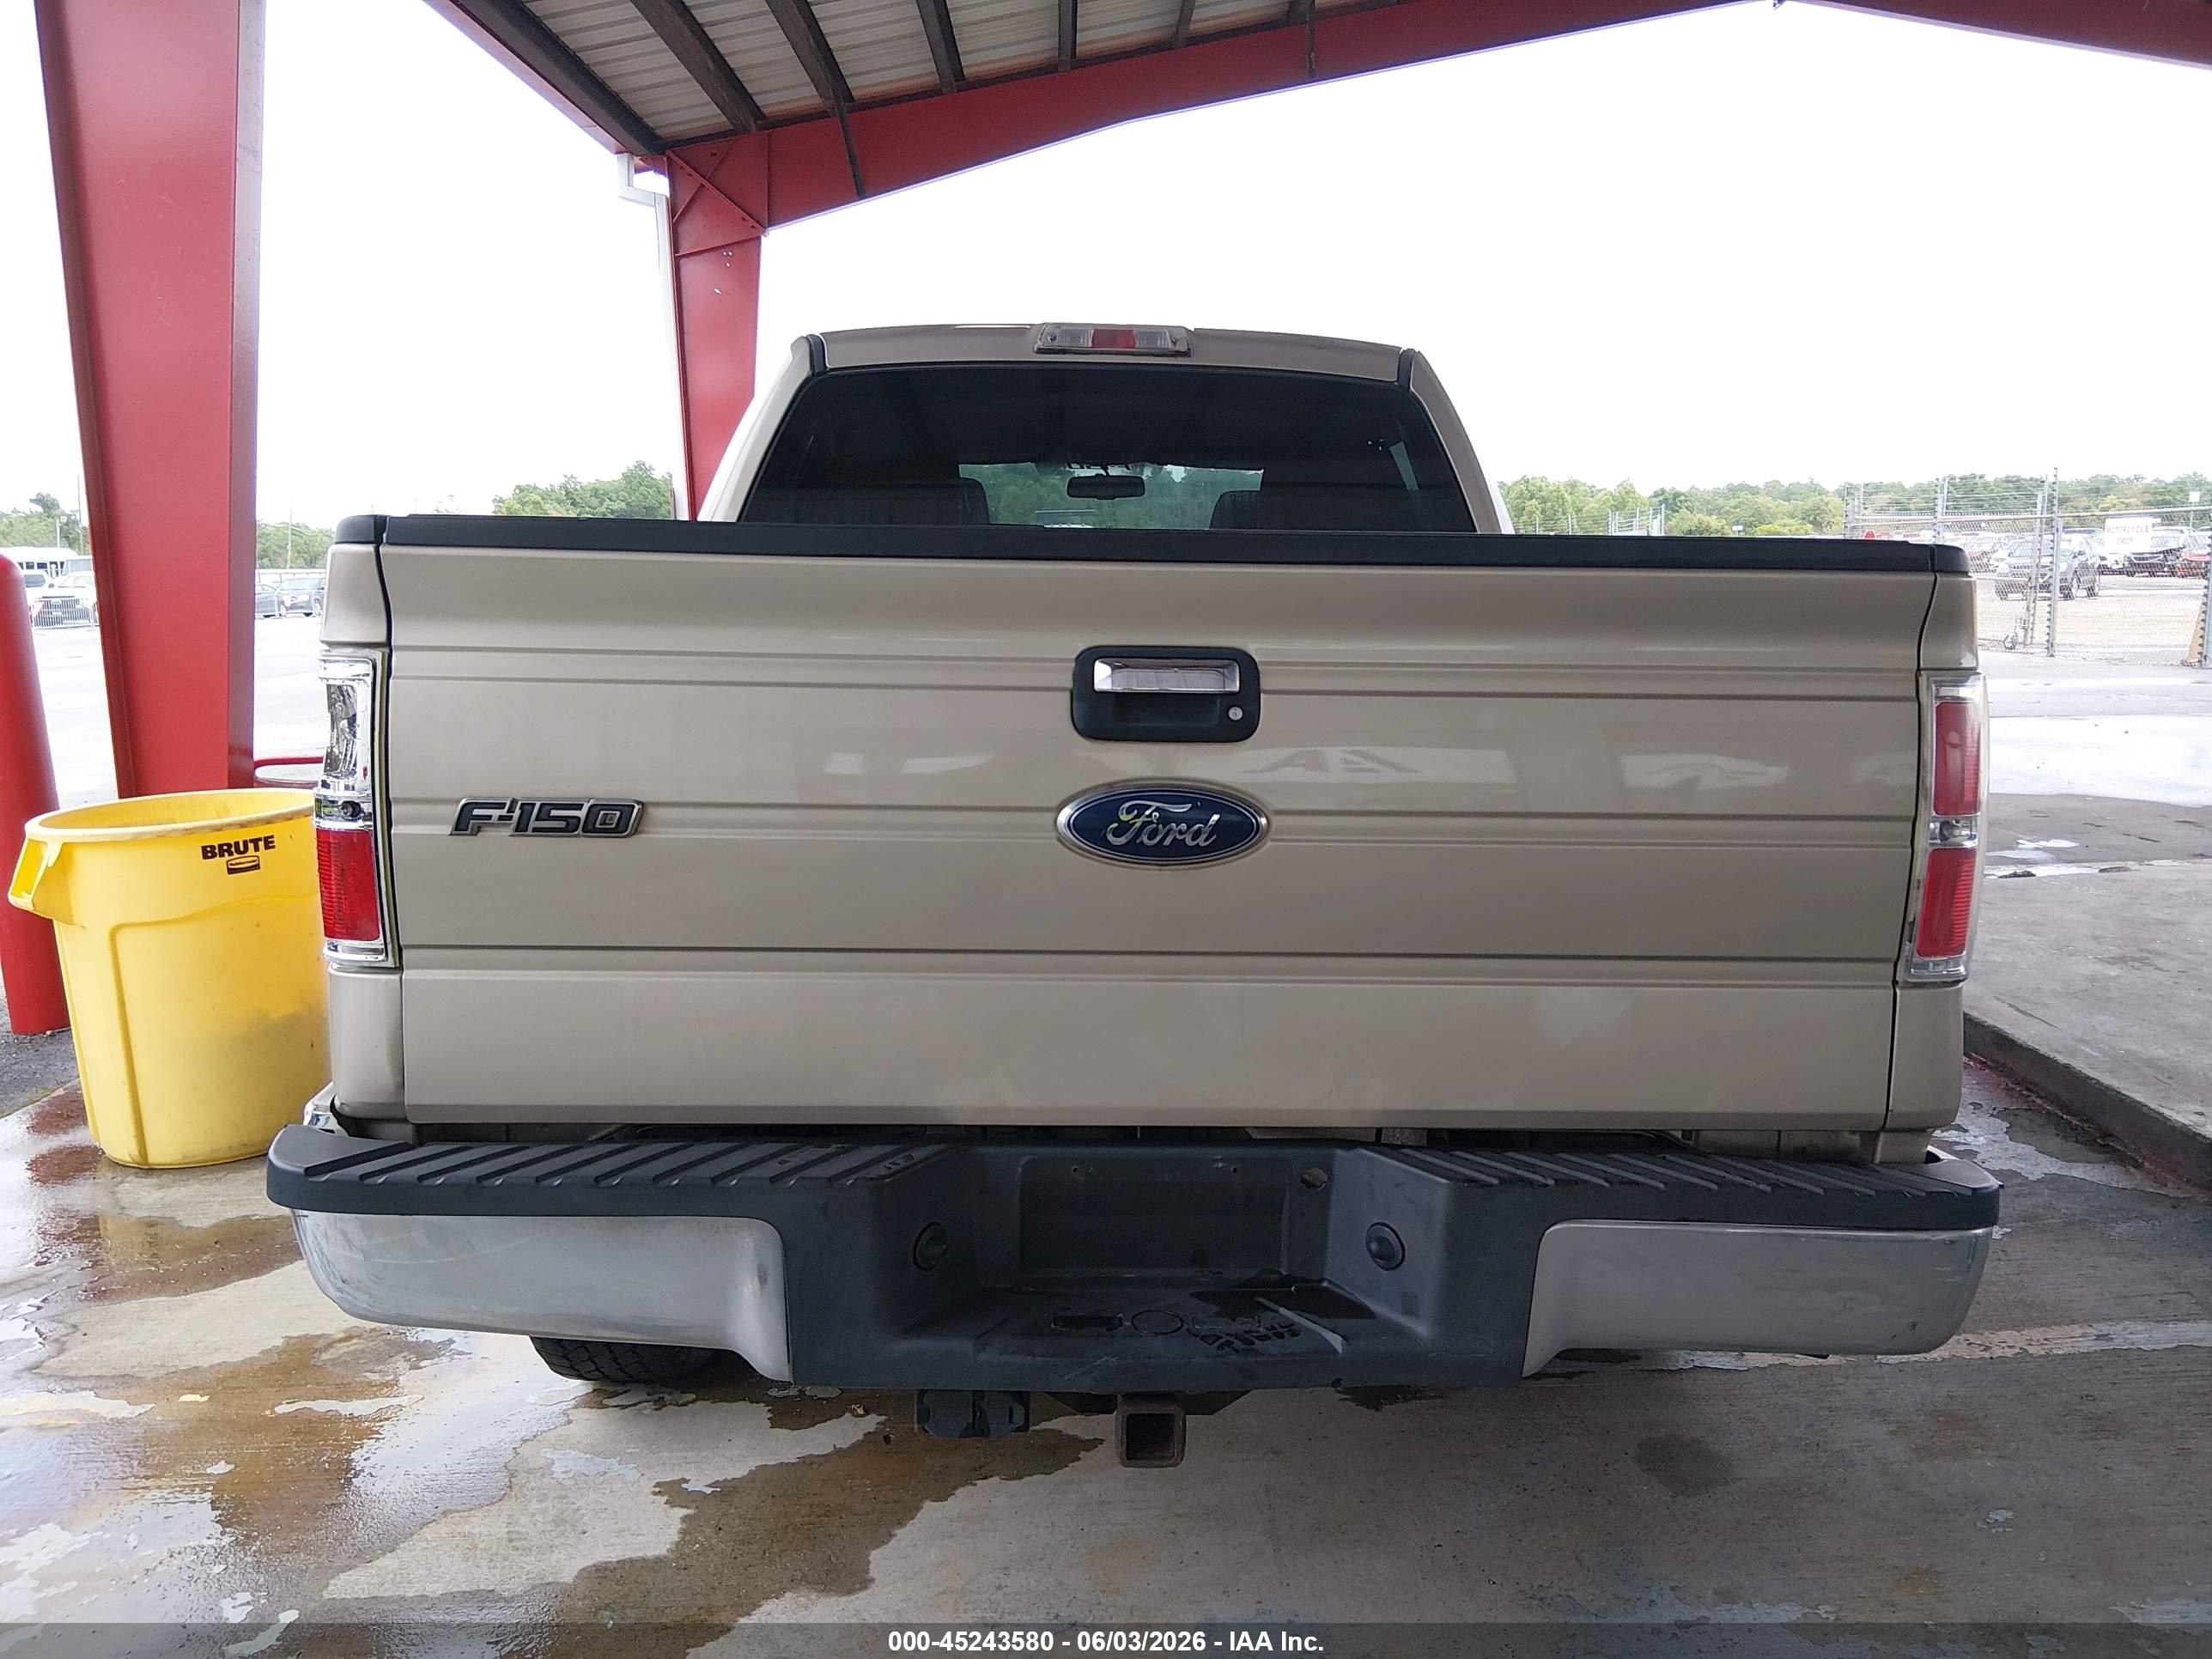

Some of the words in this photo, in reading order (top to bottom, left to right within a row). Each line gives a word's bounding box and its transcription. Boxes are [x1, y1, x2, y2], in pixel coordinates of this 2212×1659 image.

[449, 798, 644, 837] F-150
[1105, 799, 1221, 847] Ford
[201, 835, 276, 860] BRUTE
